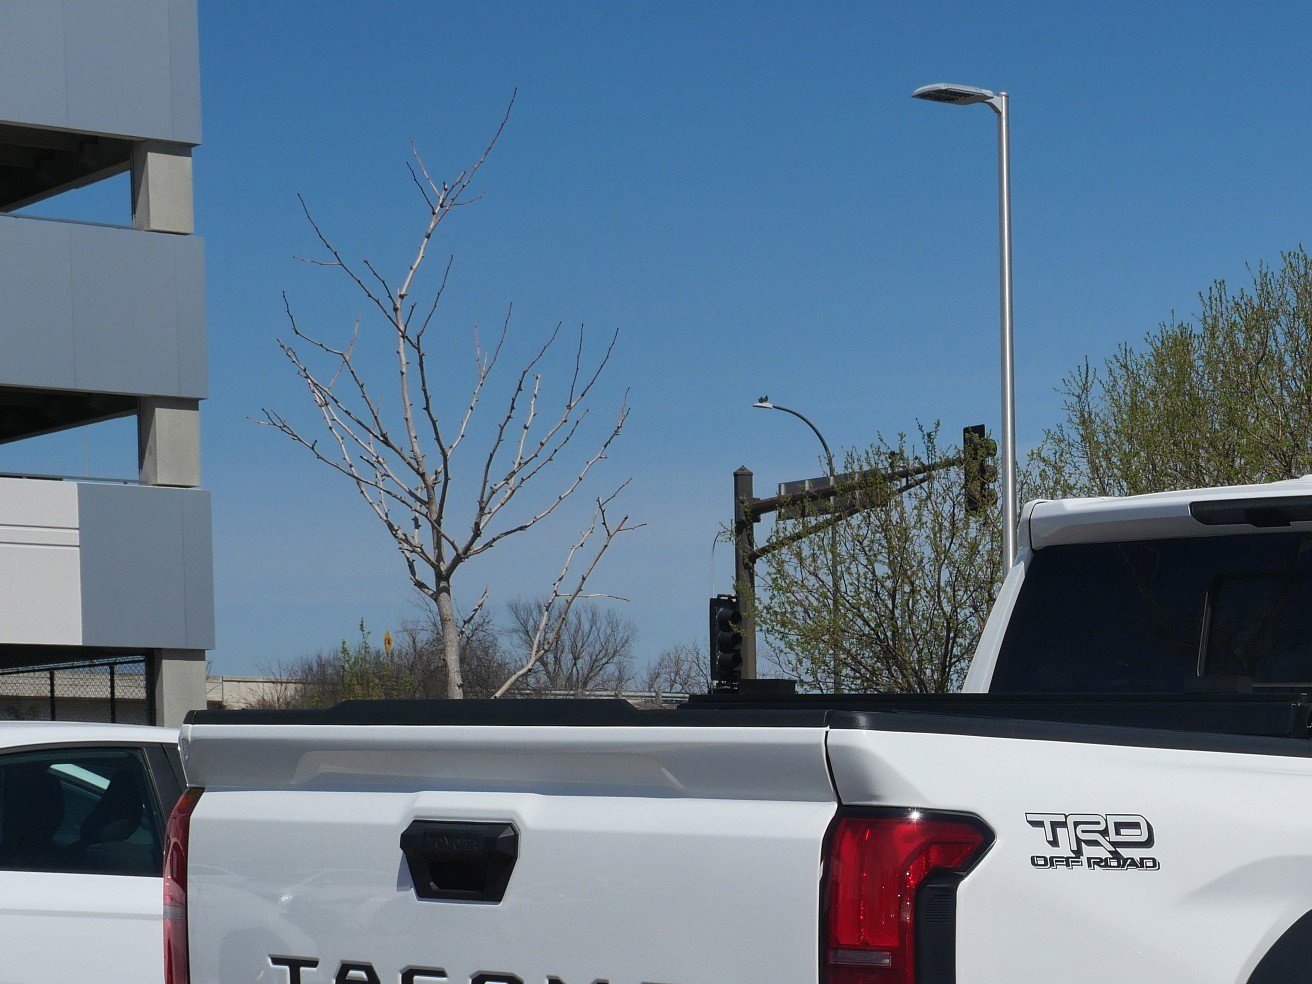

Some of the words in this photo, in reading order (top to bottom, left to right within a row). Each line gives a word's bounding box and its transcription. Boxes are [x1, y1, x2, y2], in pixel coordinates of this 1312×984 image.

[1024, 812, 1155, 858] TRD
[1030, 855, 1083, 870] OFF
[1086, 857, 1161, 871] ROAD
